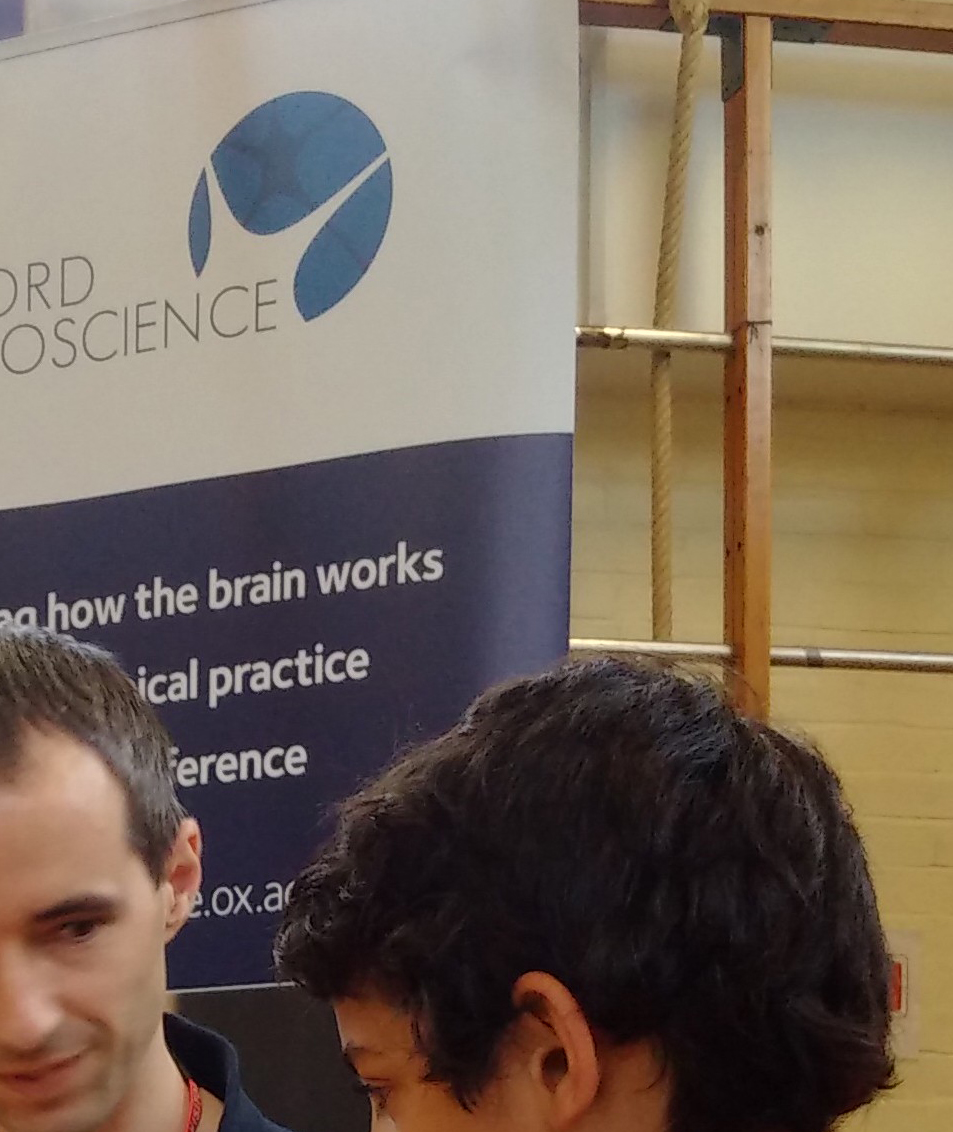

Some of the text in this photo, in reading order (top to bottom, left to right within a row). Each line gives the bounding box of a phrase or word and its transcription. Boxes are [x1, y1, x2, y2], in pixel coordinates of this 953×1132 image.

[47, 591, 127, 631] how
[134, 576, 197, 620] the
[208, 561, 306, 610] brain
[316, 540, 444, 595] works
[208, 643, 370, 709] practice
